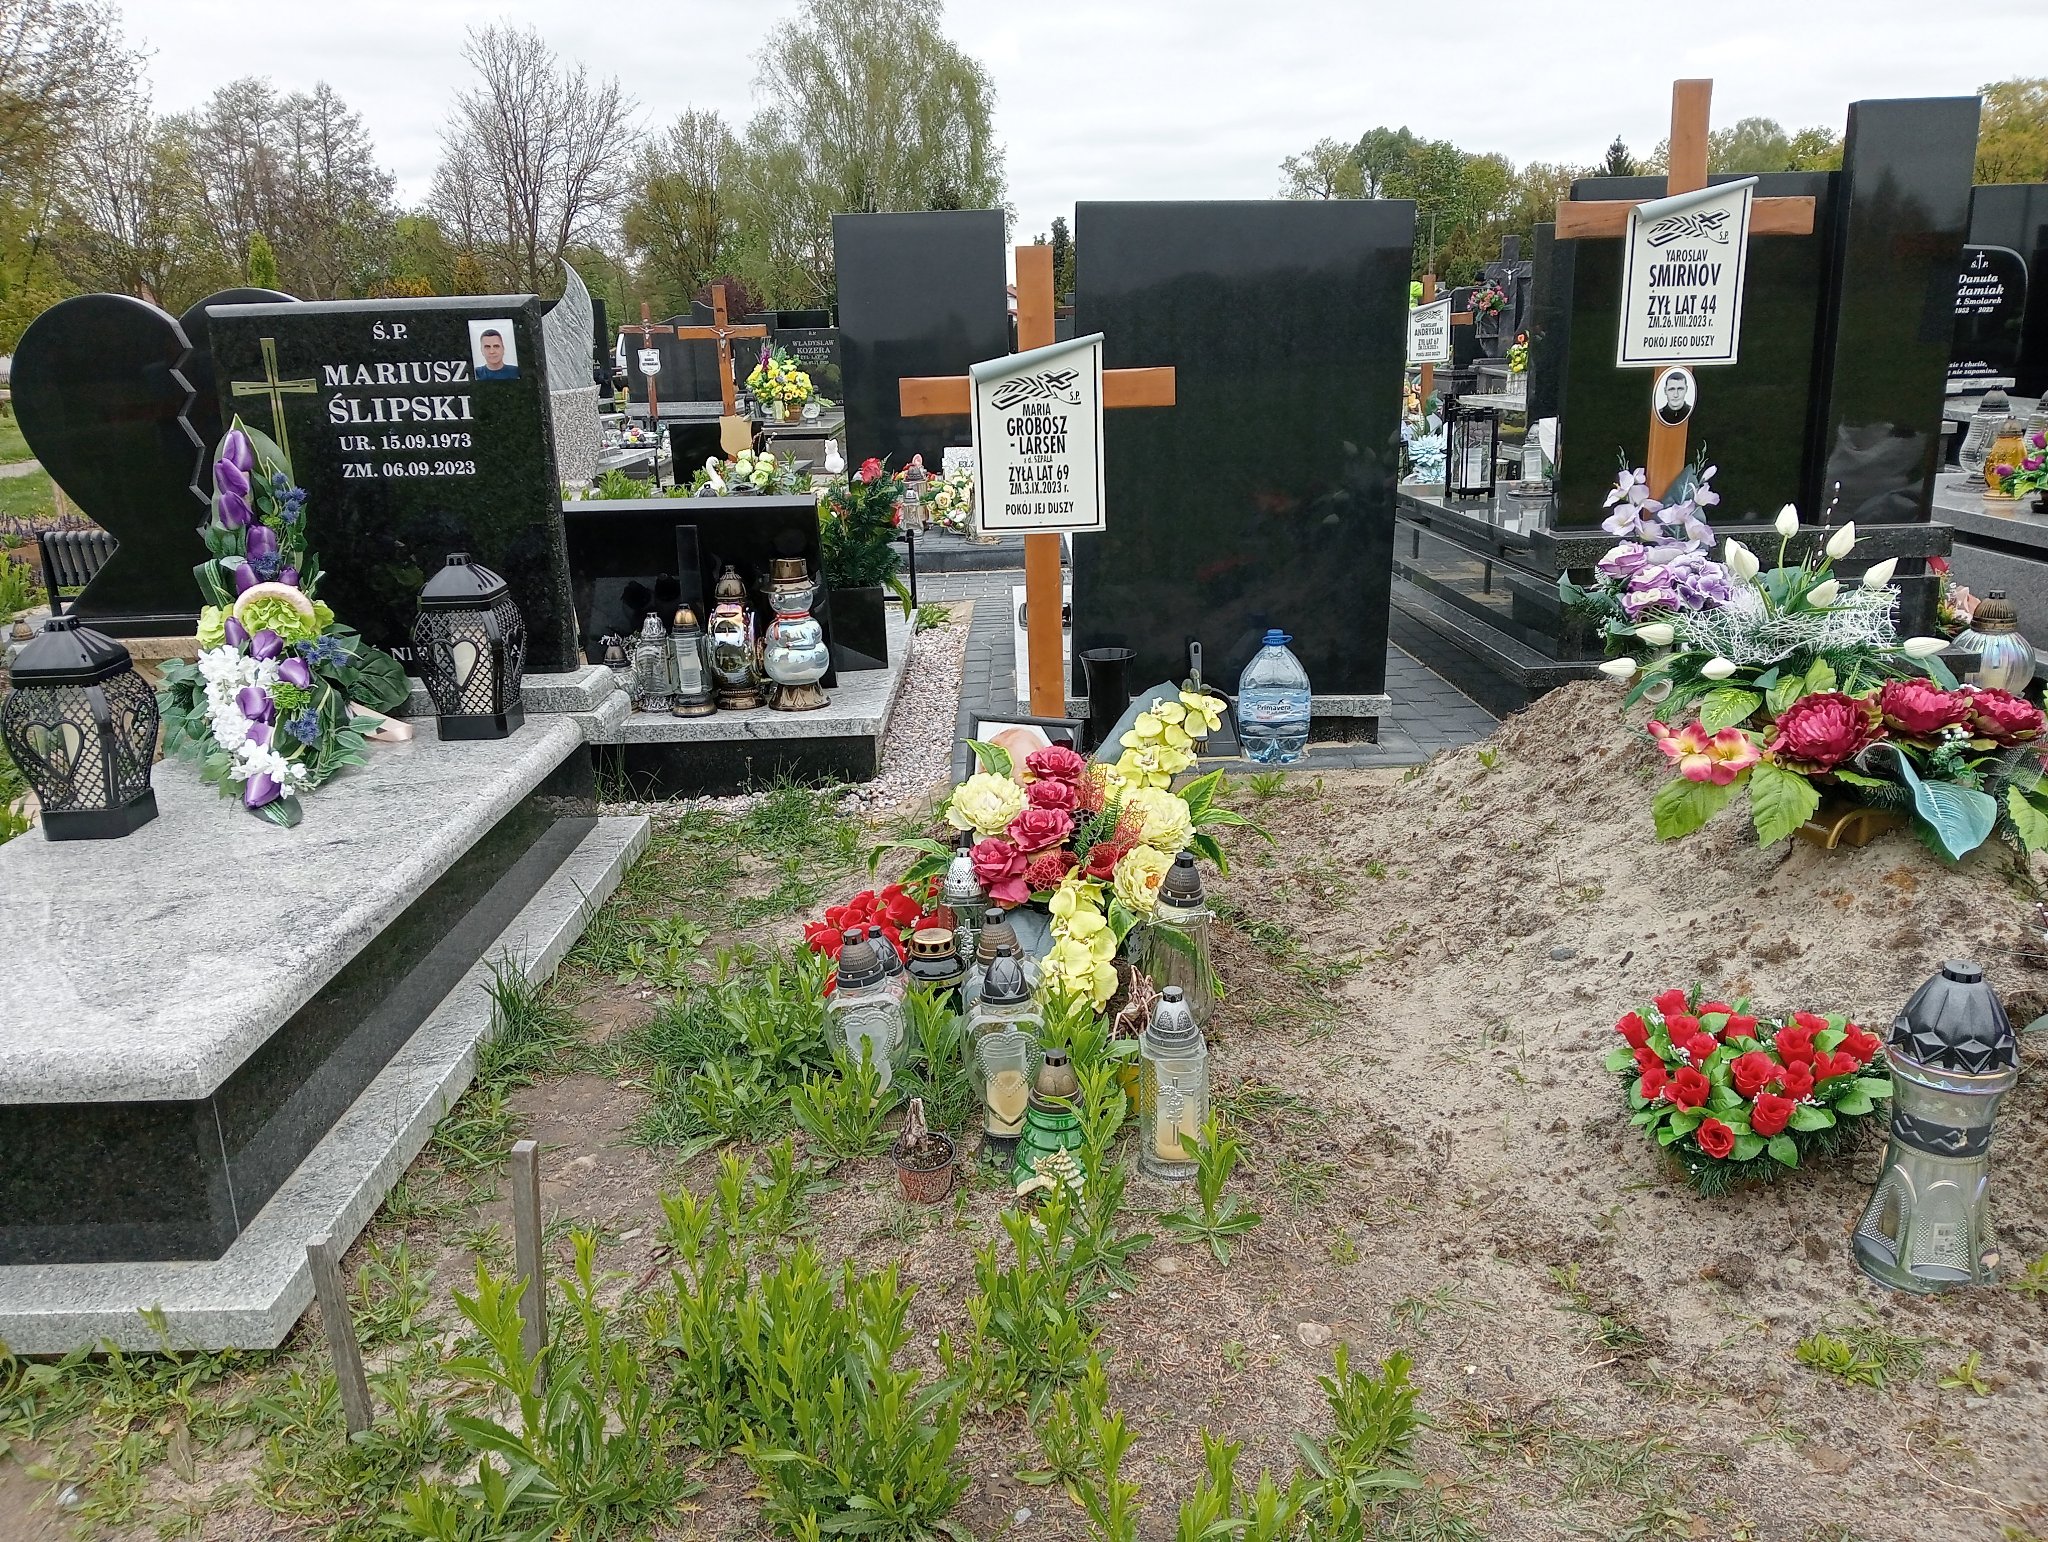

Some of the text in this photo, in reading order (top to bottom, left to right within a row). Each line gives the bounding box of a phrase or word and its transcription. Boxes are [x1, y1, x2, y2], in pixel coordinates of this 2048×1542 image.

[1666, 249, 1708, 262] YAROSLAV
[1649, 263, 1722, 287] SMIRNOV
[1958, 273, 1999, 284] Danuta
[1957, 283, 2005, 296] damiak
[1647, 289, 1717, 316] ŻYŁ LAT 44
[1963, 296, 2003, 306] Smolarek
[1648, 315, 1714, 328] ZM.26.VIII.2023 r.
[372, 321, 408, 340] Ś.P.
[1414, 327, 1443, 336] ANDRYSIAK
[1670, 336, 1688, 347] JEGO
[1690, 335, 1715, 347] DUSZY
[322, 360, 469, 387] MARIUSZ
[328, 392, 474, 424] ŚLIPSKI
[1022, 403, 1051, 416] MARIA
[1006, 416, 1068, 437] GROBOSZ
[339, 433, 472, 451] UR. 15.09.1973
[1019, 435, 1066, 455] LARSEN
[342, 461, 476, 478] ZM. 06.09.2023
[1008, 462, 1069, 482] ŻYŁA LAT 69
[1009, 481, 1069, 495] ZM.3.IX.2023 r.
[1005, 500, 1074, 515] POKÓJ JEJ DUSZY
[1256, 703, 1291, 712] Primavera
